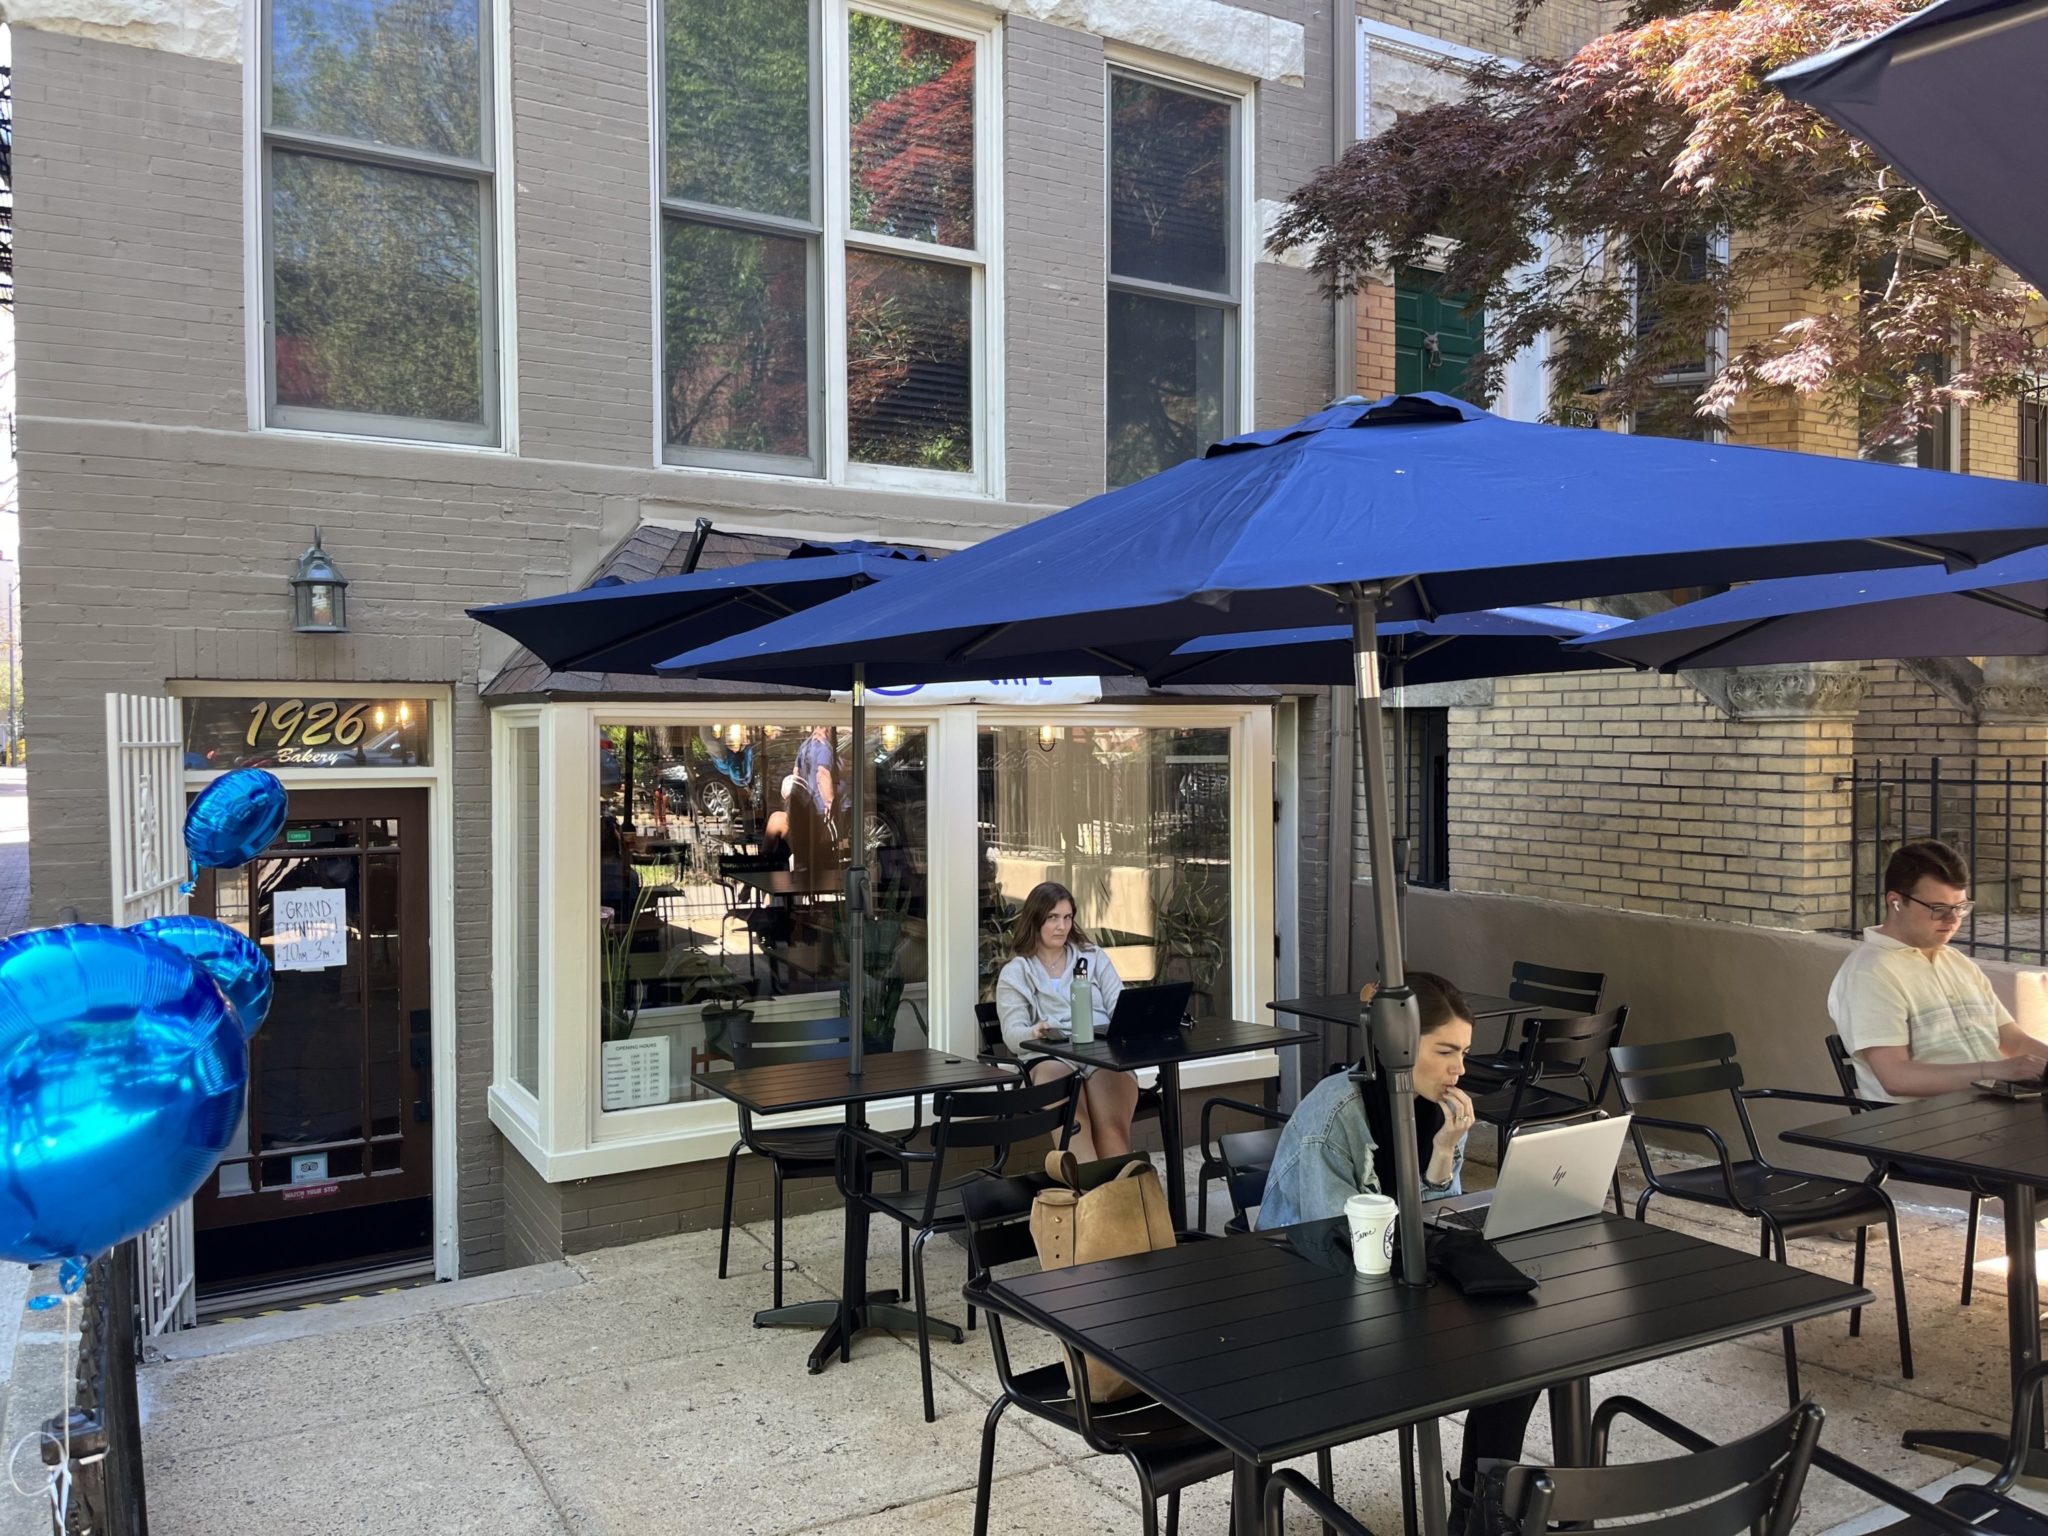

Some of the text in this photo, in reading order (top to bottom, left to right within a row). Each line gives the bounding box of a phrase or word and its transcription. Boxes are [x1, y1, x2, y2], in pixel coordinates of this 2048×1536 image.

[247, 699, 370, 747] 1926
[277, 748, 340, 764] Bakery
[286, 900, 332, 919] GRAND
